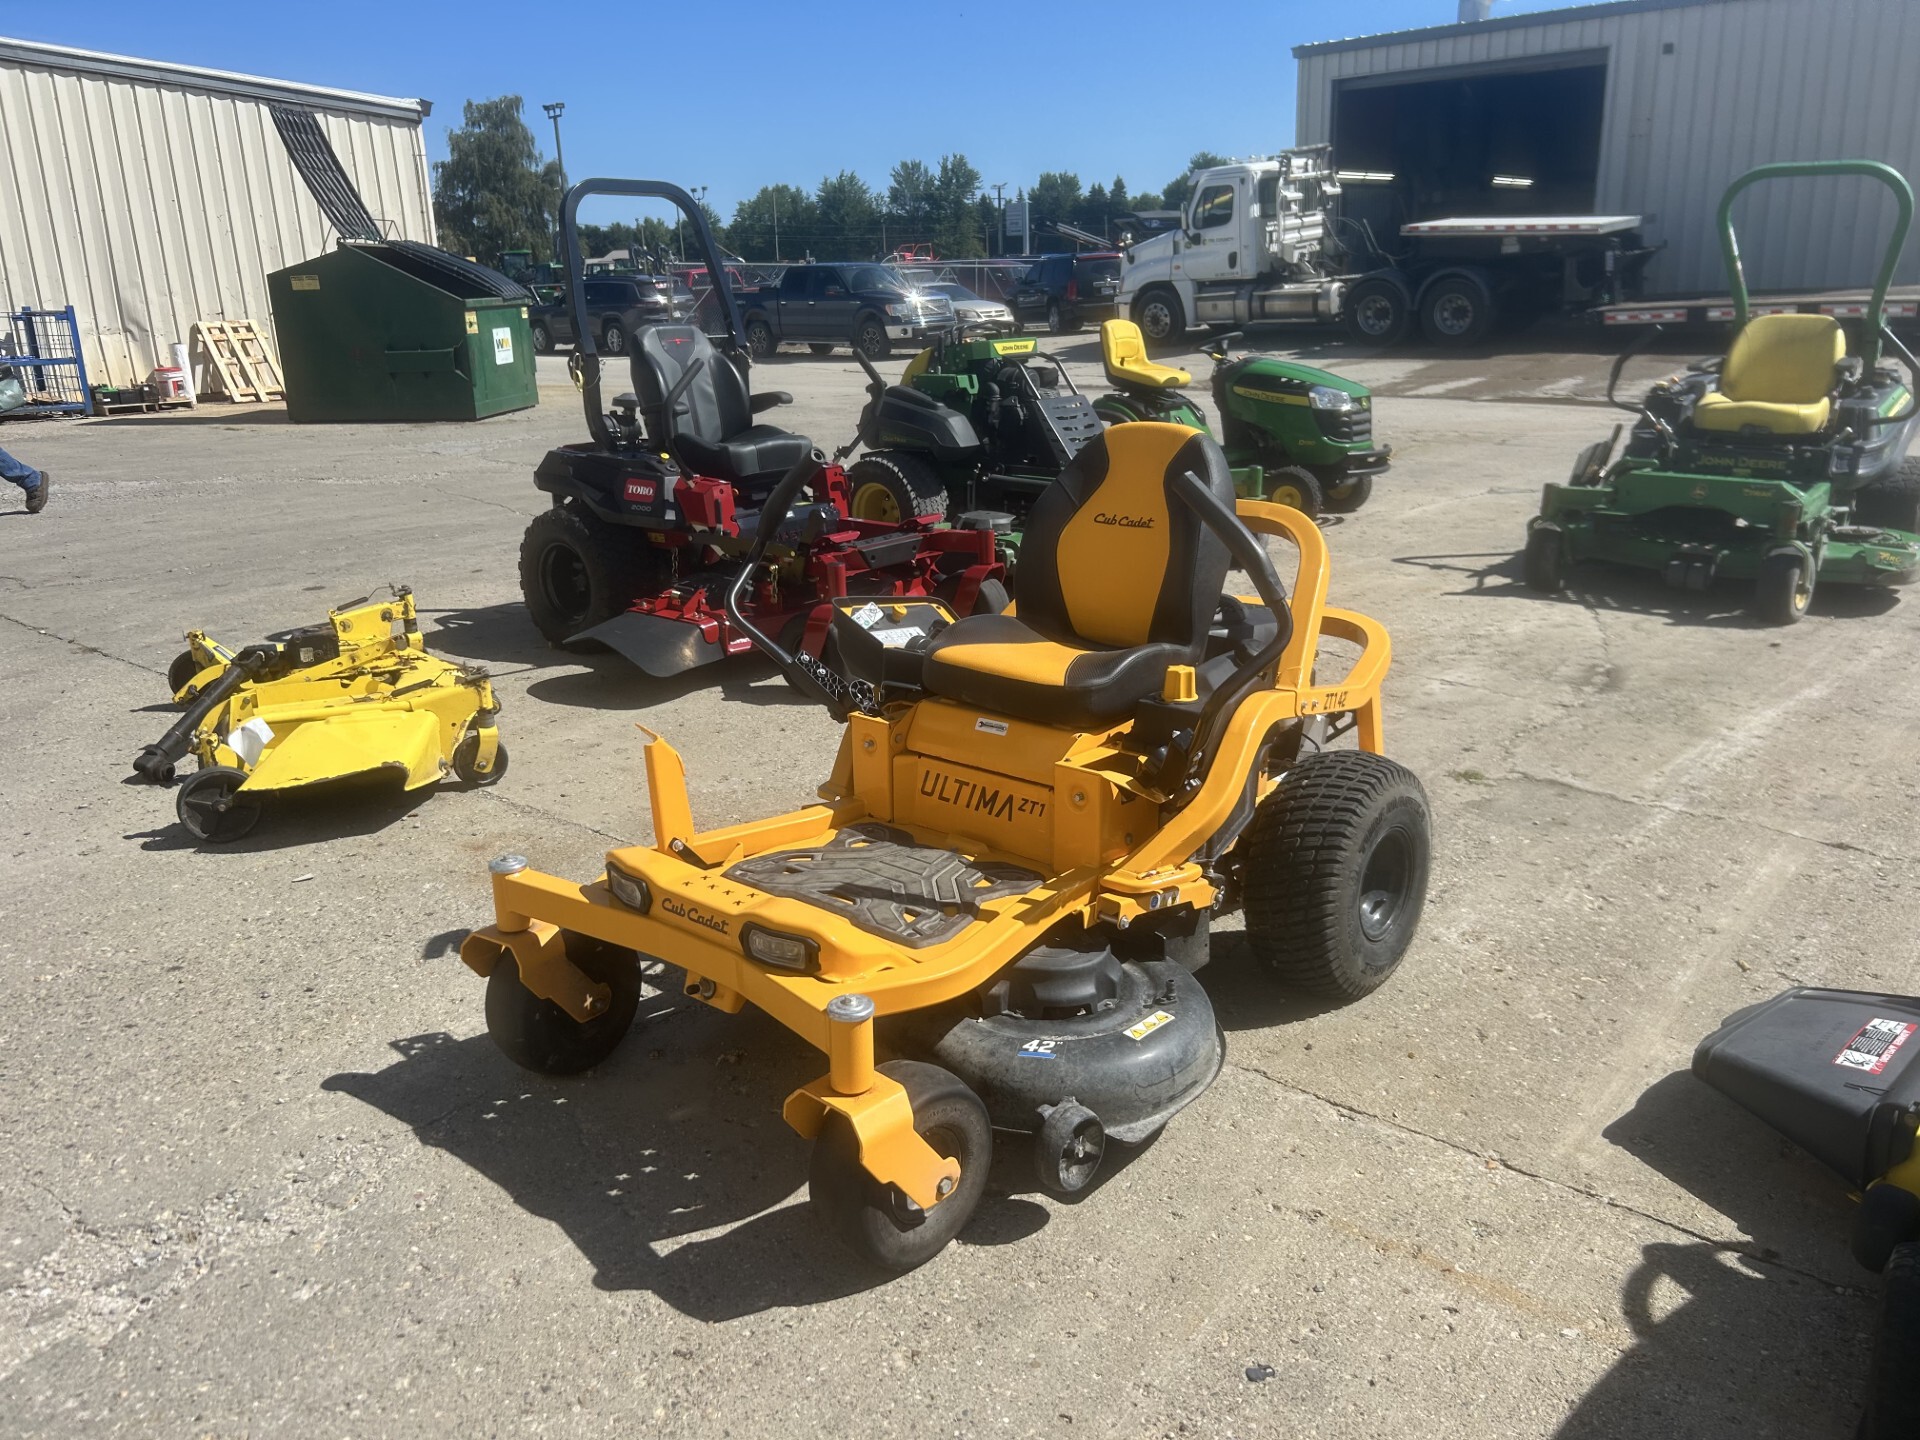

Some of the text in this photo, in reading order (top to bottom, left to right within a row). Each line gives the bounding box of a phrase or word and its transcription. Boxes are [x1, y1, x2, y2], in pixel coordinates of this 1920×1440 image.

[1697, 455, 1787, 470] JOHN DEERE
[627, 484, 654, 496] TORO
[631, 504, 652, 512] 2000
[1094, 513, 1155, 529] Cub Cadet
[920, 769, 1047, 822] ULTIMA ZT1
[662, 897, 730, 936] Cub Cadet
